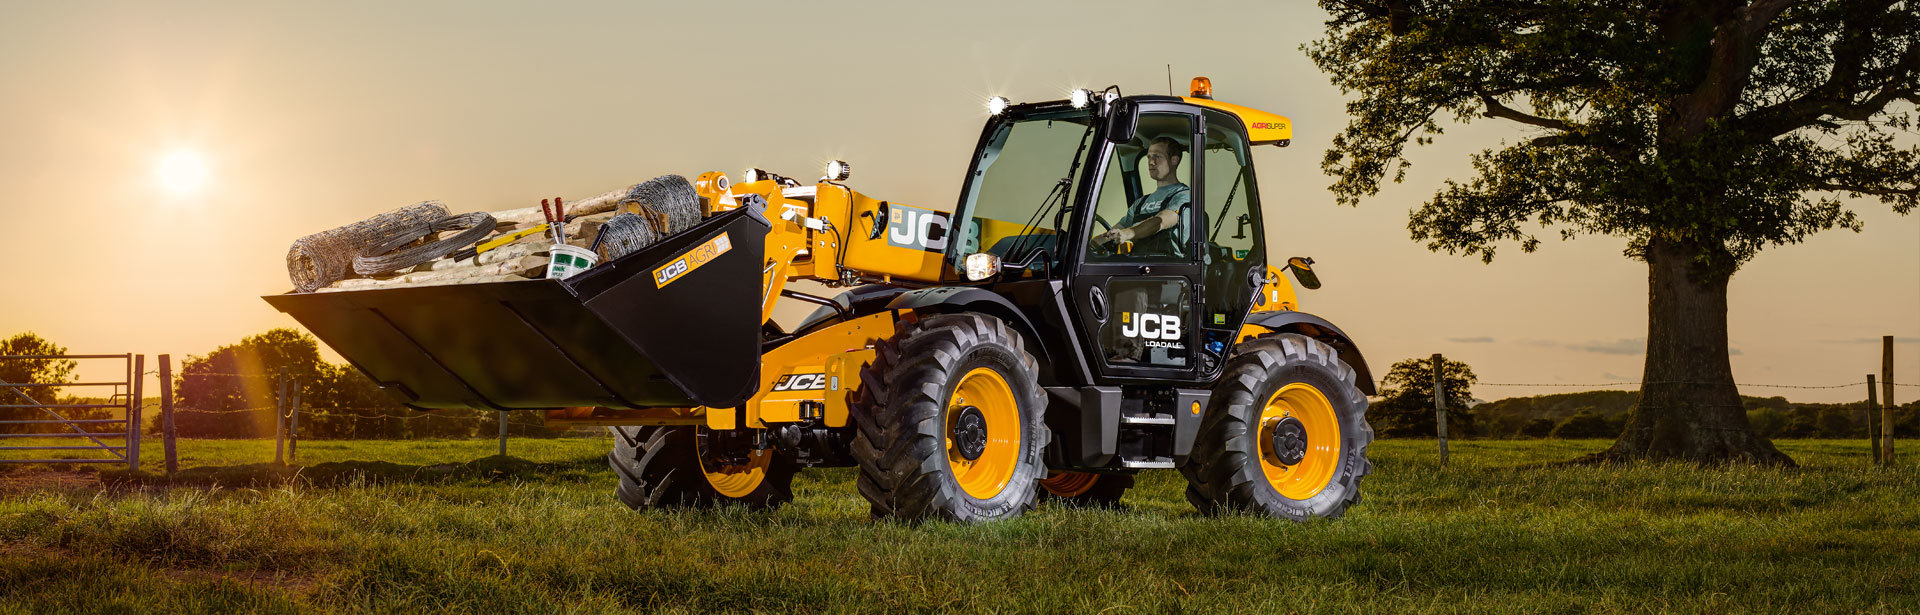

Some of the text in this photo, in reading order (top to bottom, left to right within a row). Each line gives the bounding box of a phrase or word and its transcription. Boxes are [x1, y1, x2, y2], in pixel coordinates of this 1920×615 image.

[657, 241, 717, 284] JCB AGRI
[1122, 312, 1181, 340] JCB
[1145, 340, 1181, 349] LOADALL
